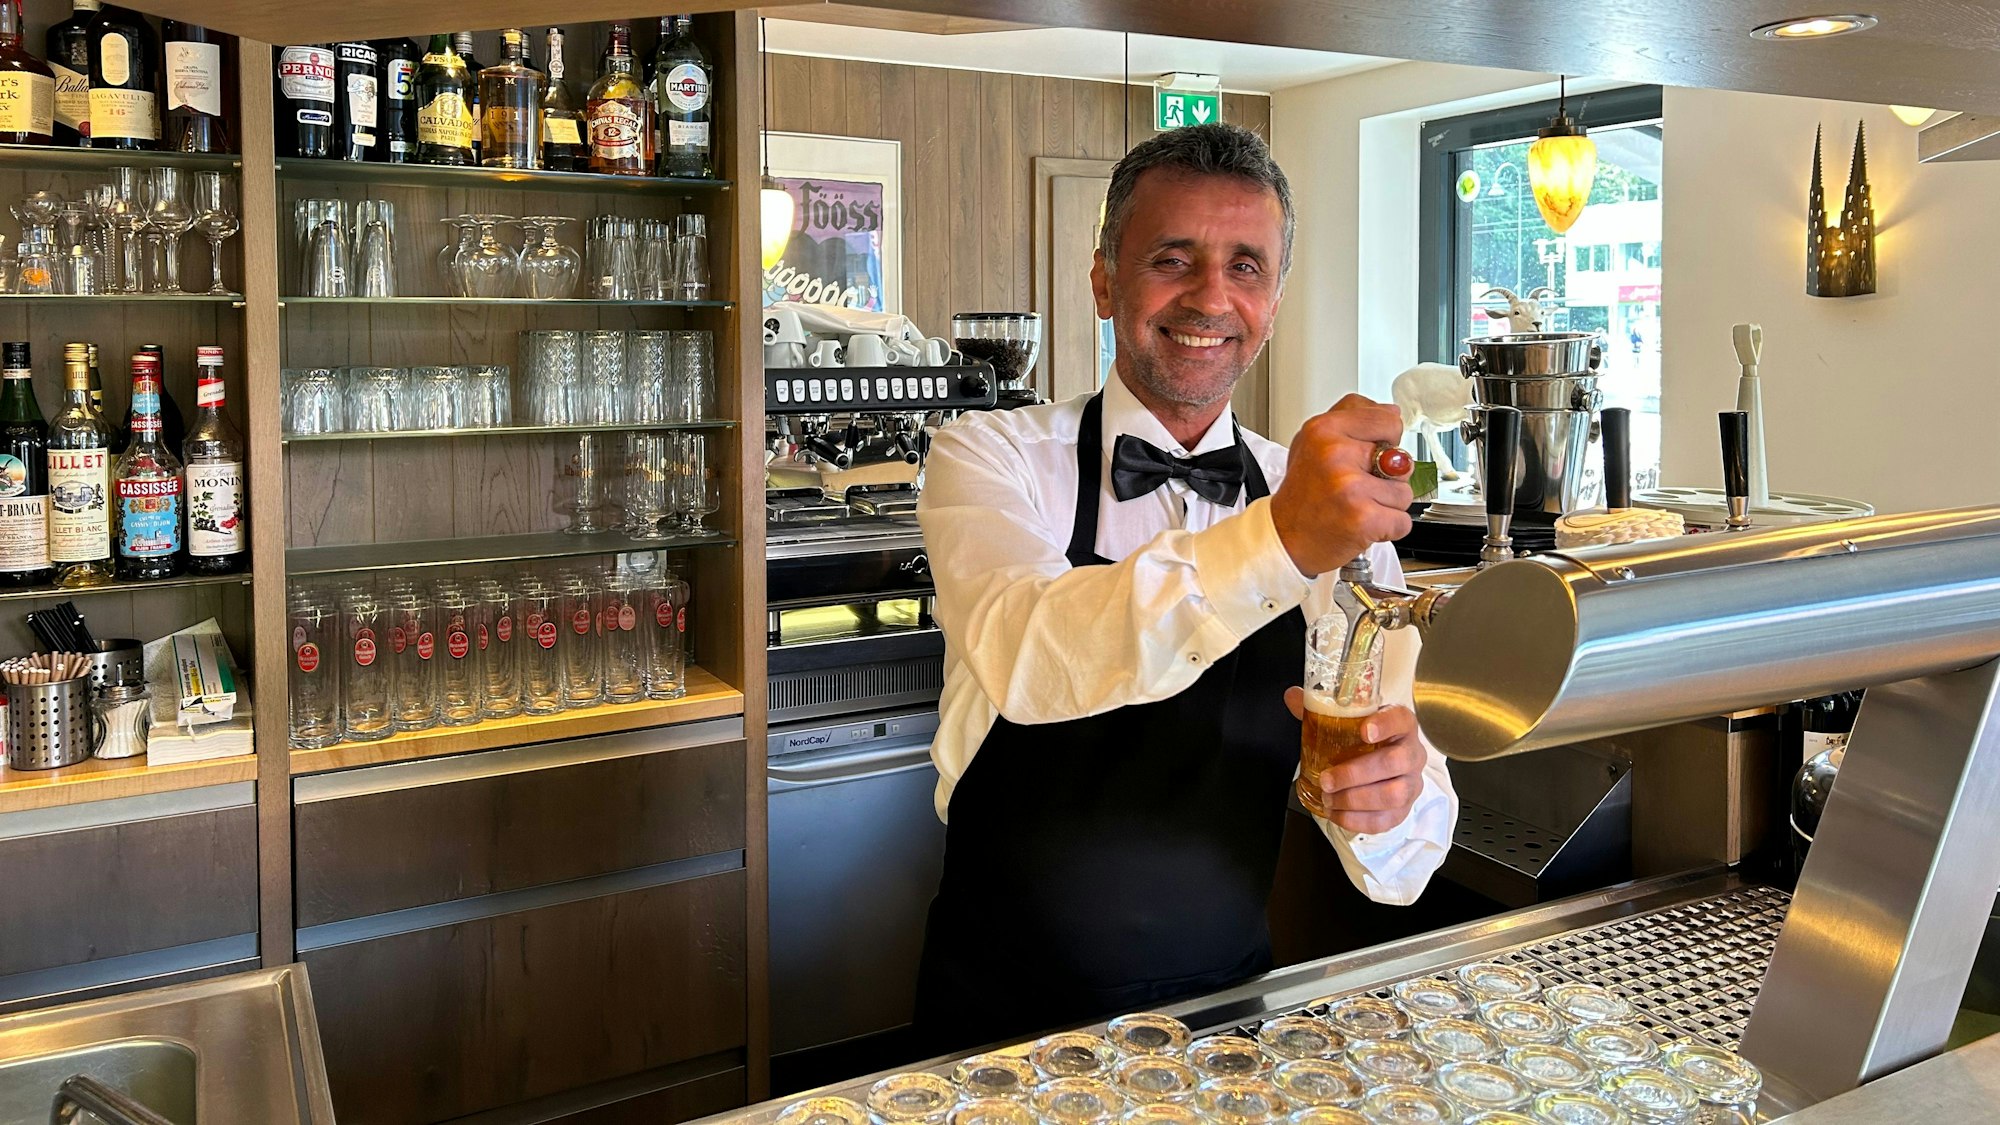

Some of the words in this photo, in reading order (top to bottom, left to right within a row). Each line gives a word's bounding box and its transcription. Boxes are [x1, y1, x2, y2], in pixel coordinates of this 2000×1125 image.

[281, 63, 335, 79] PERNO
[670, 83, 707, 94] MARTINI
[91, 93, 147, 102] LAGAVULIN
[420, 116, 473, 131] CALVADOS
[592, 116, 612, 129] CHIVAS
[614, 116, 638, 130] REGAL
[131, 419, 163, 429] CASSISSÉE
[120, 480, 179, 495] CASSISSÉE
[194, 475, 243, 488] MONIN
[75, 525, 103, 534] BLANC
[789, 736, 826, 748] NordCap
